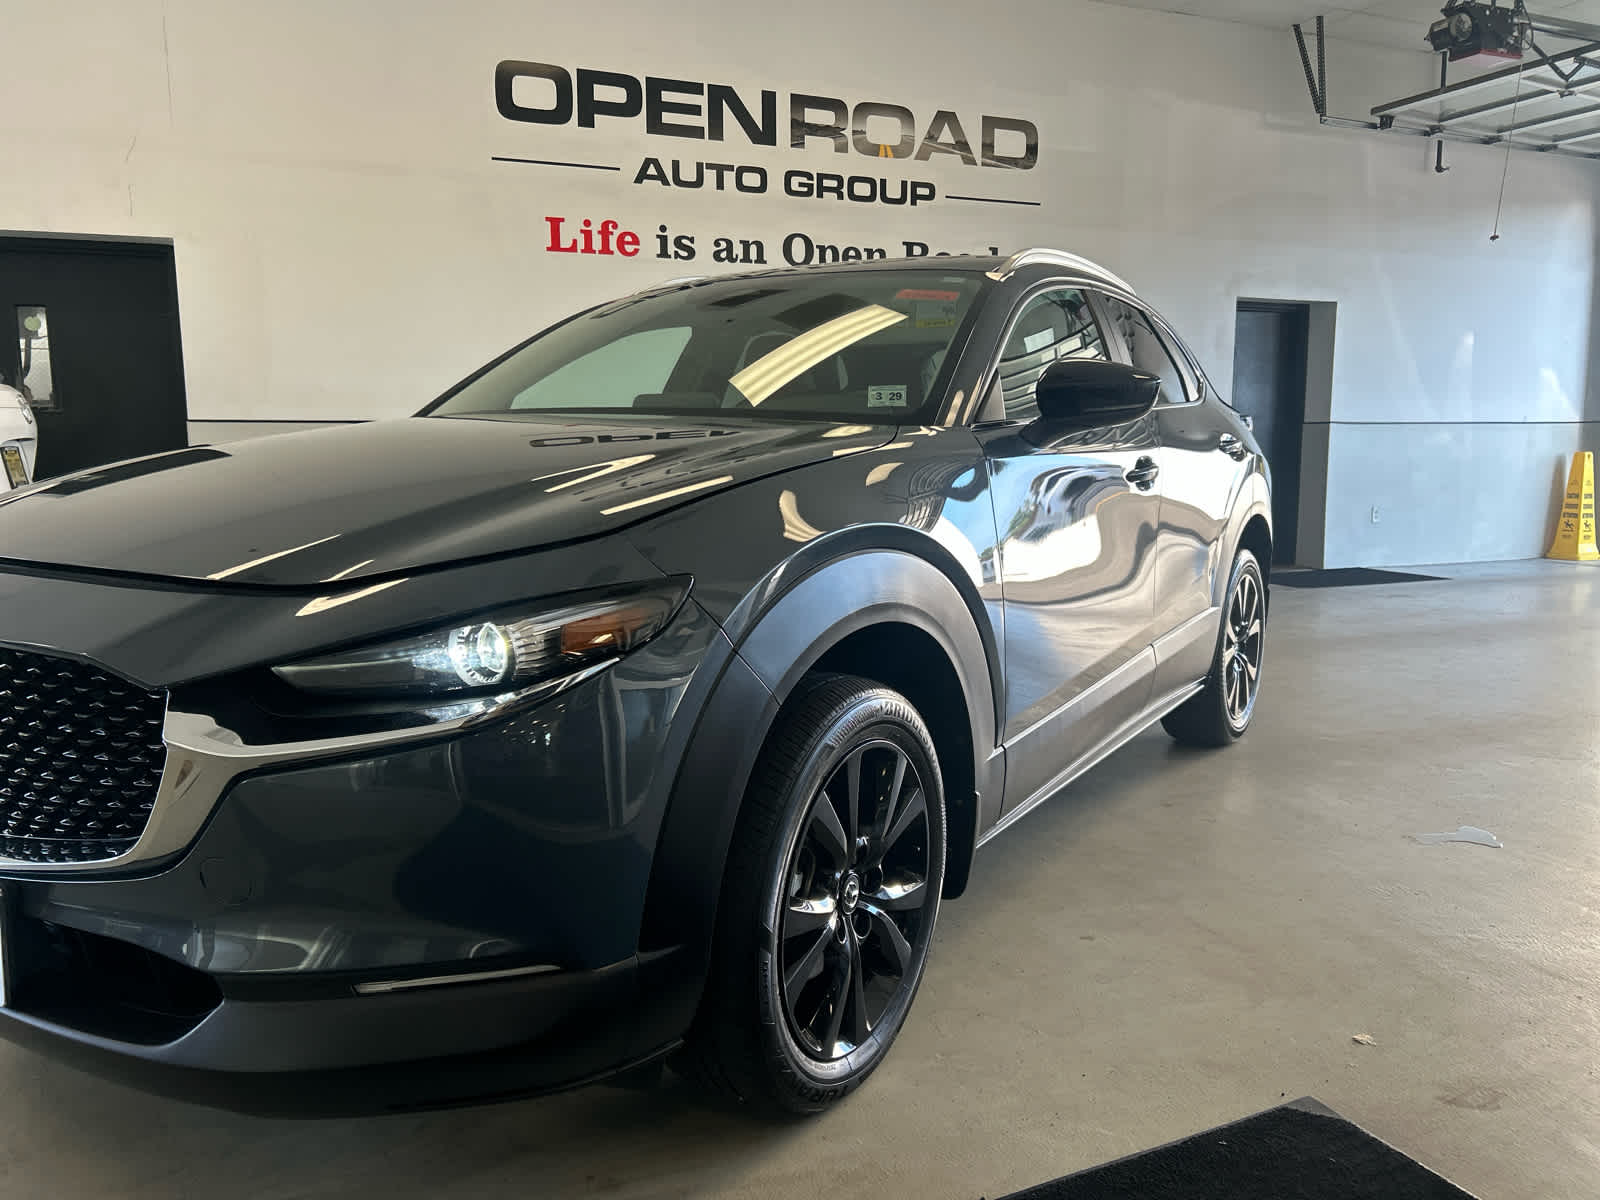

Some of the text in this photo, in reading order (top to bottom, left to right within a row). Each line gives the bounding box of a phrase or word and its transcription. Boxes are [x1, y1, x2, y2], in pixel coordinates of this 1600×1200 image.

[633, 157, 936, 207] AUTO GROUP
[545, 215, 641, 257] Life
[655, 224, 696, 261] is
[712, 237, 768, 265] an
[875, 391, 903, 401] 3 29
